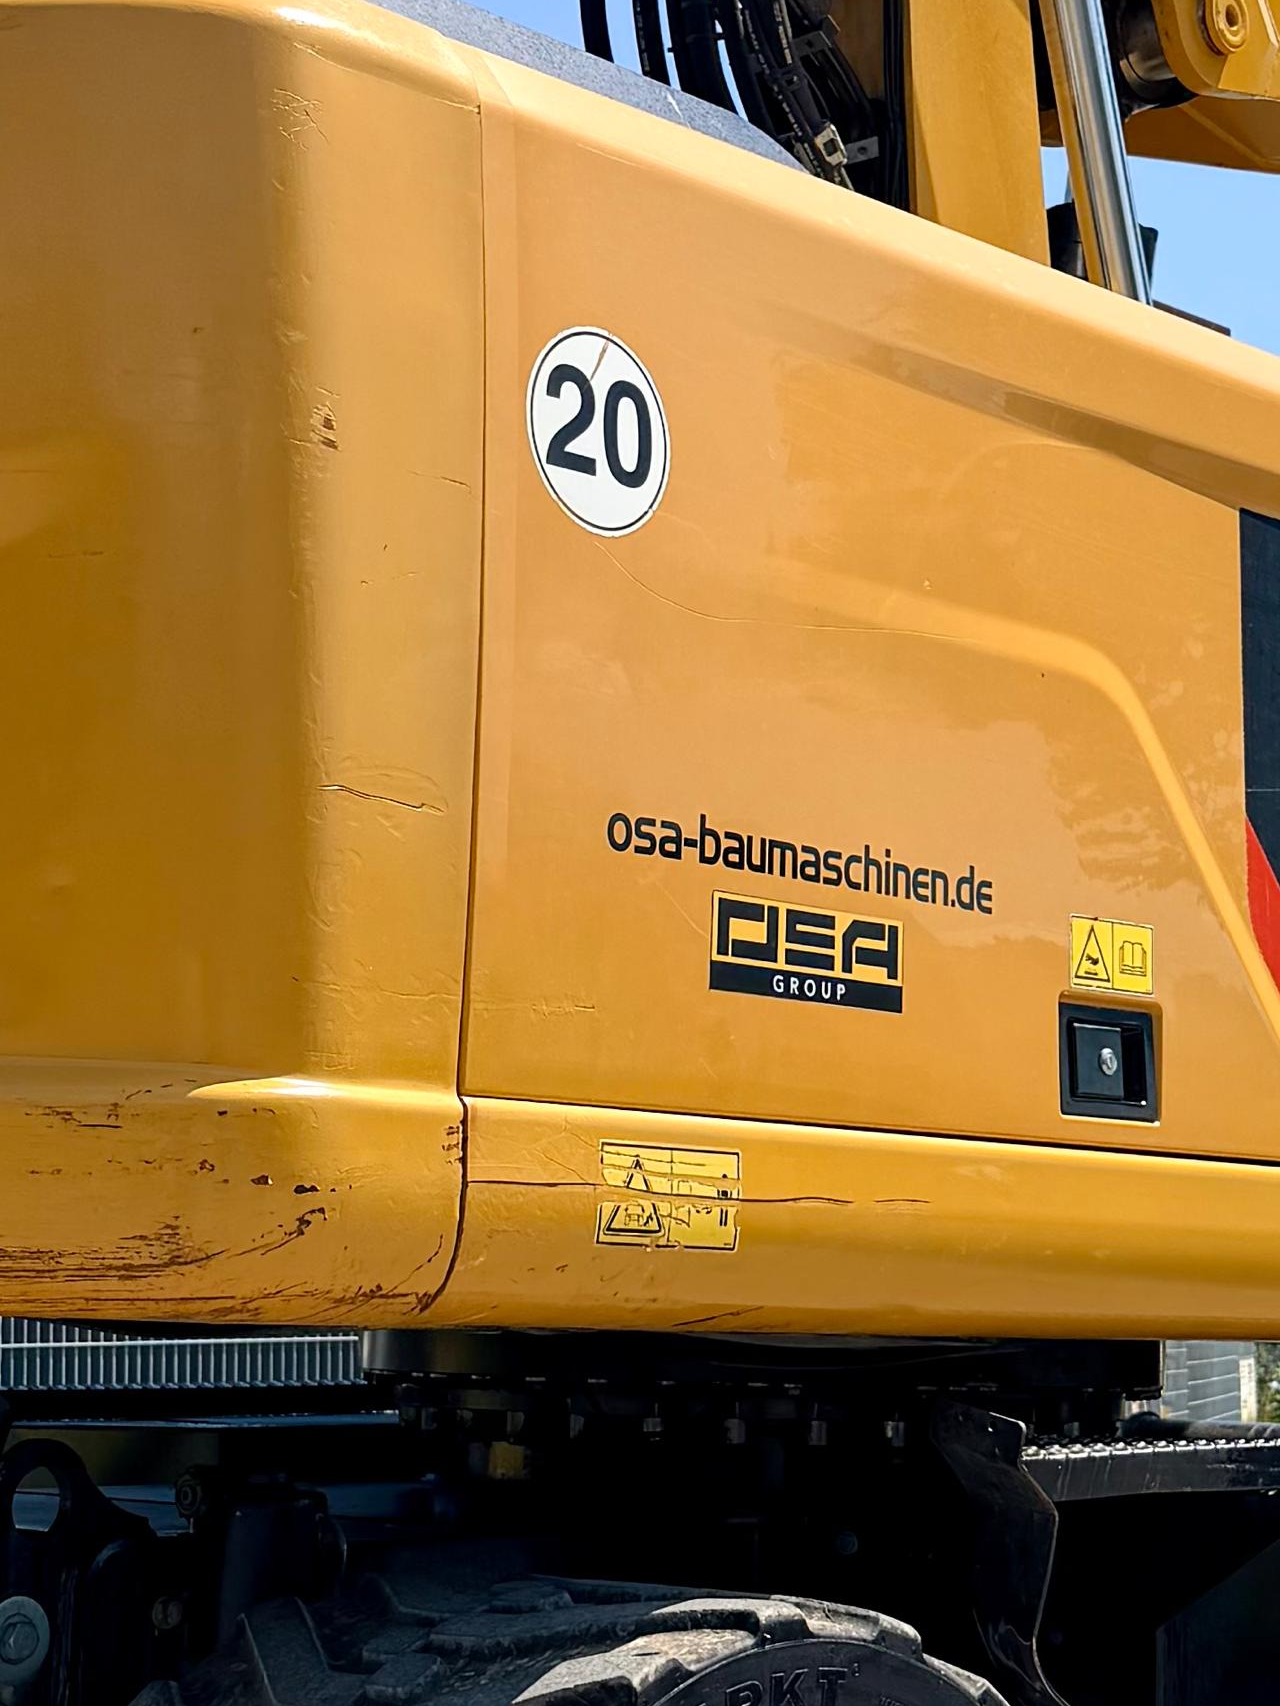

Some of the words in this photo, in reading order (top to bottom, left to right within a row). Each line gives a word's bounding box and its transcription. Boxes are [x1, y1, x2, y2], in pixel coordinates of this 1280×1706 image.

[544, 362, 653, 491] 20
[606, 812, 994, 915] osa-baumaschinen.de
[772, 974, 847, 1001] GROUP
